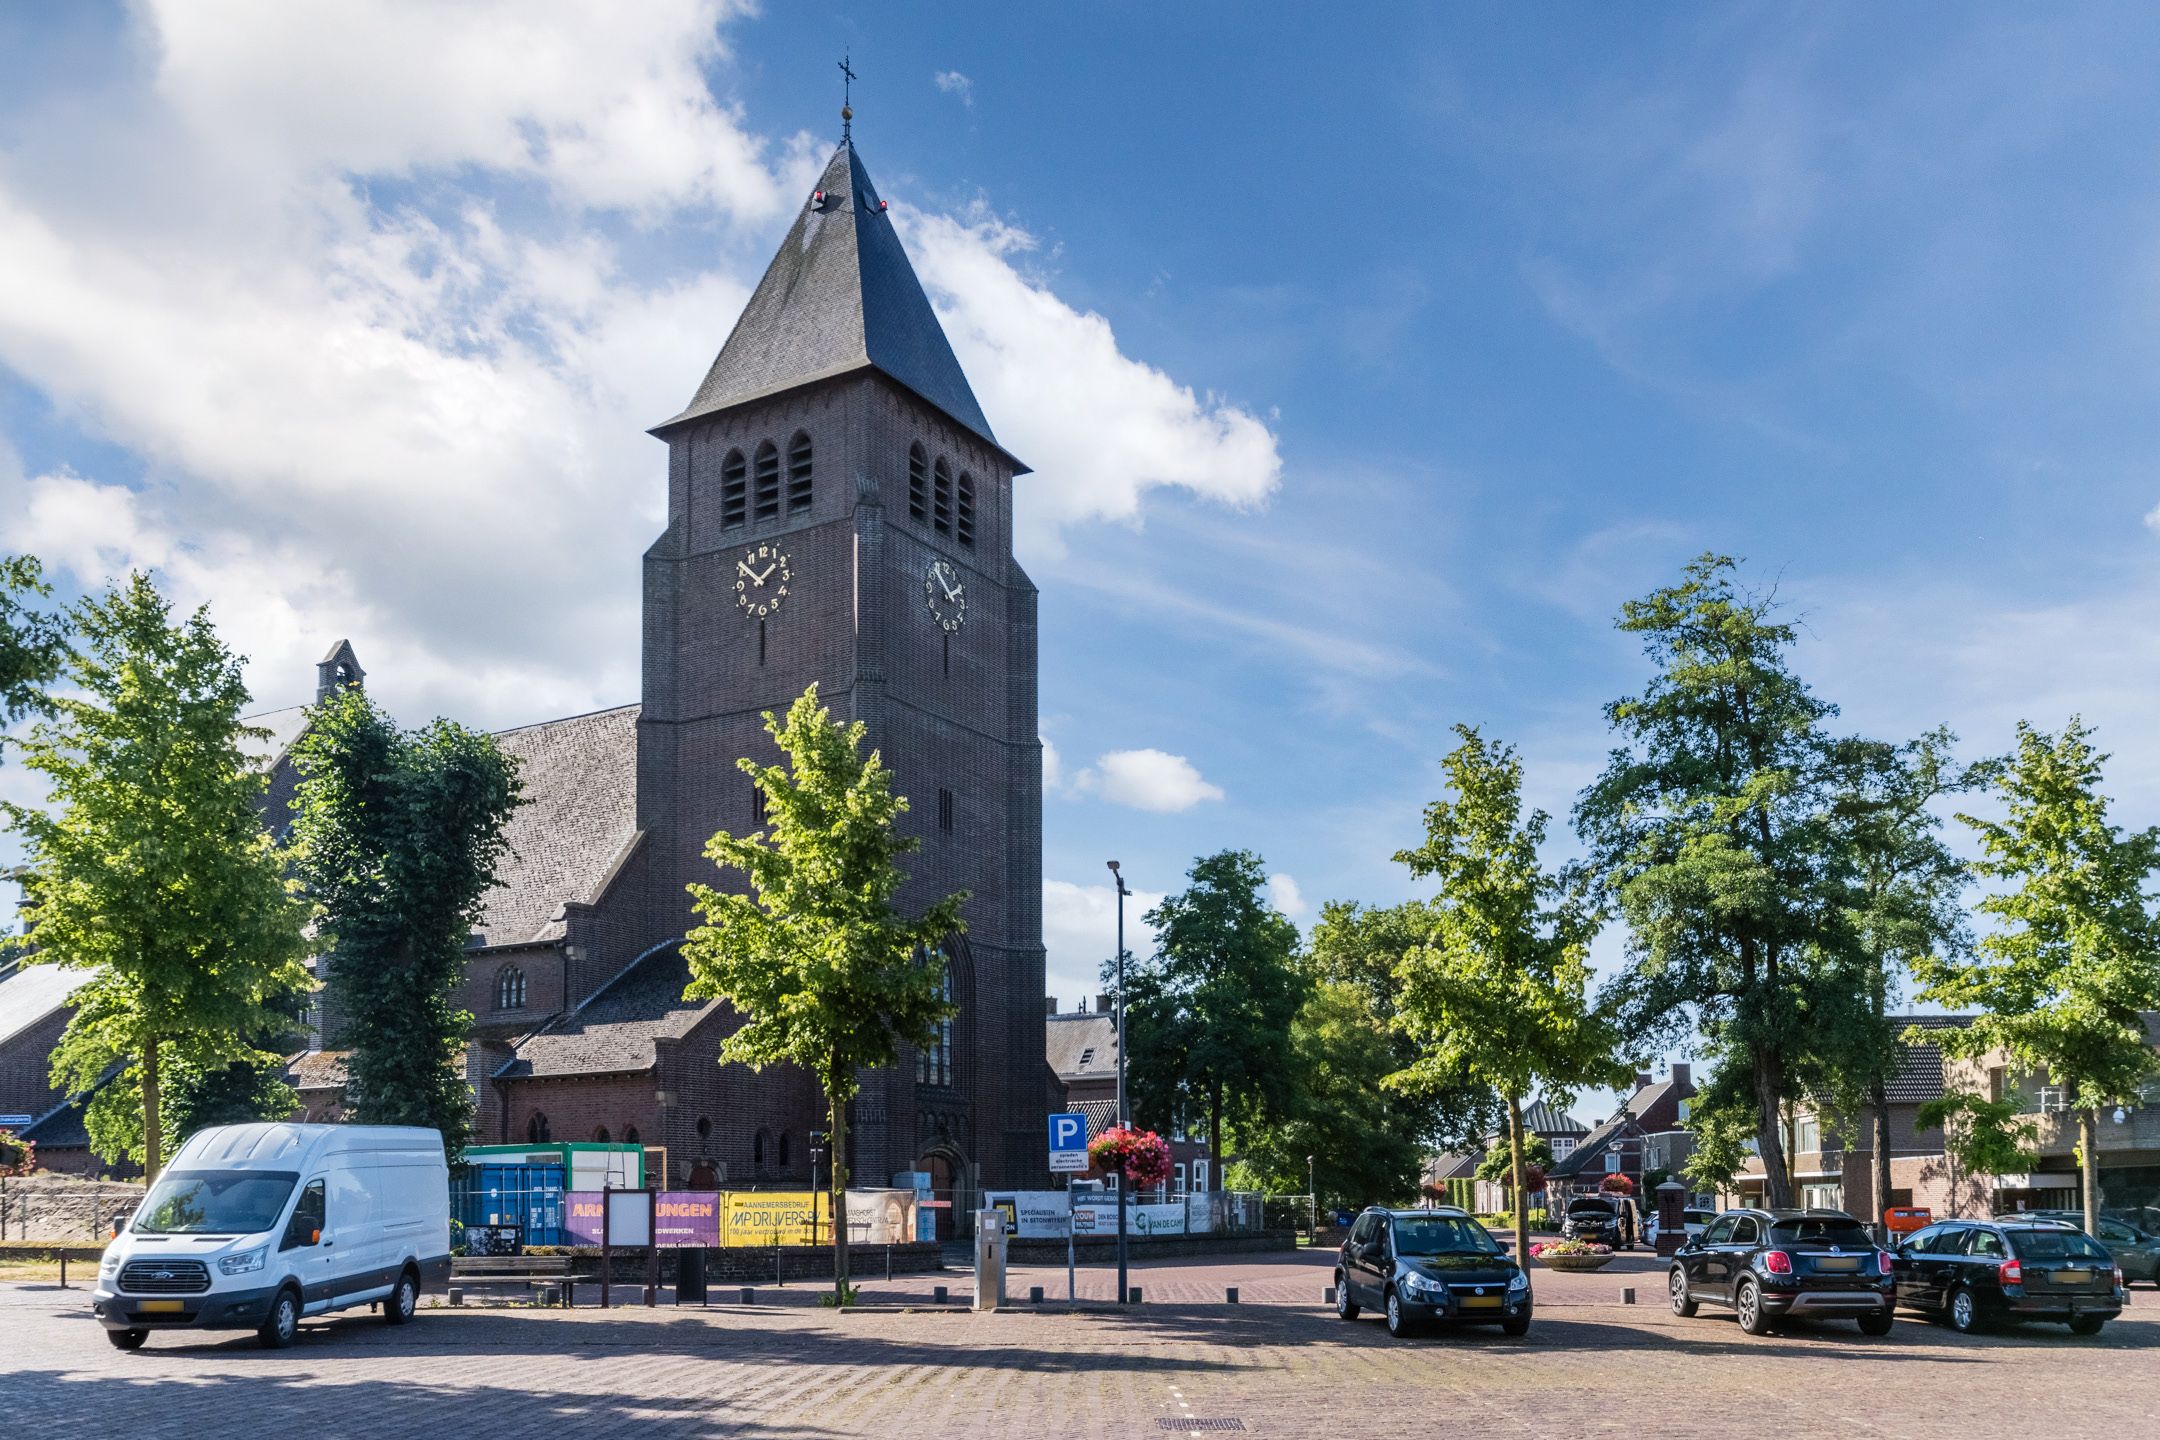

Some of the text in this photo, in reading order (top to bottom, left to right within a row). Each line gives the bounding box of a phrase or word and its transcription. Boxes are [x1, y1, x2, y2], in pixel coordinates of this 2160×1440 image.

[758, 546, 768, 558] 12
[772, 548, 776, 559] 1
[748, 553, 755, 564] 11
[780, 556, 786, 567] 2
[942, 562, 950, 574] 12
[782, 570, 790, 580] 3
[952, 571, 956, 581] 1
[736, 580, 745, 592] 9
[778, 585, 788, 596] 4
[926, 582, 932, 593] 9
[740, 594, 747, 606] 8
[771, 598, 778, 609] 5
[928, 598, 934, 609] 8
[960, 599, 965, 610] 3
[748, 603, 756, 614] 7
[758, 604, 767, 616] 6
[935, 612, 941, 621] 7
[957, 612, 963, 623] 4
[943, 619, 950, 630] 6
[952, 620, 958, 630] 5
[1058, 1119, 1078, 1146] P
[730, 1212, 752, 1226] MP
[753, 1210, 805, 1226] DRIJVERS
[1163, 1220, 1170, 1228] DE
